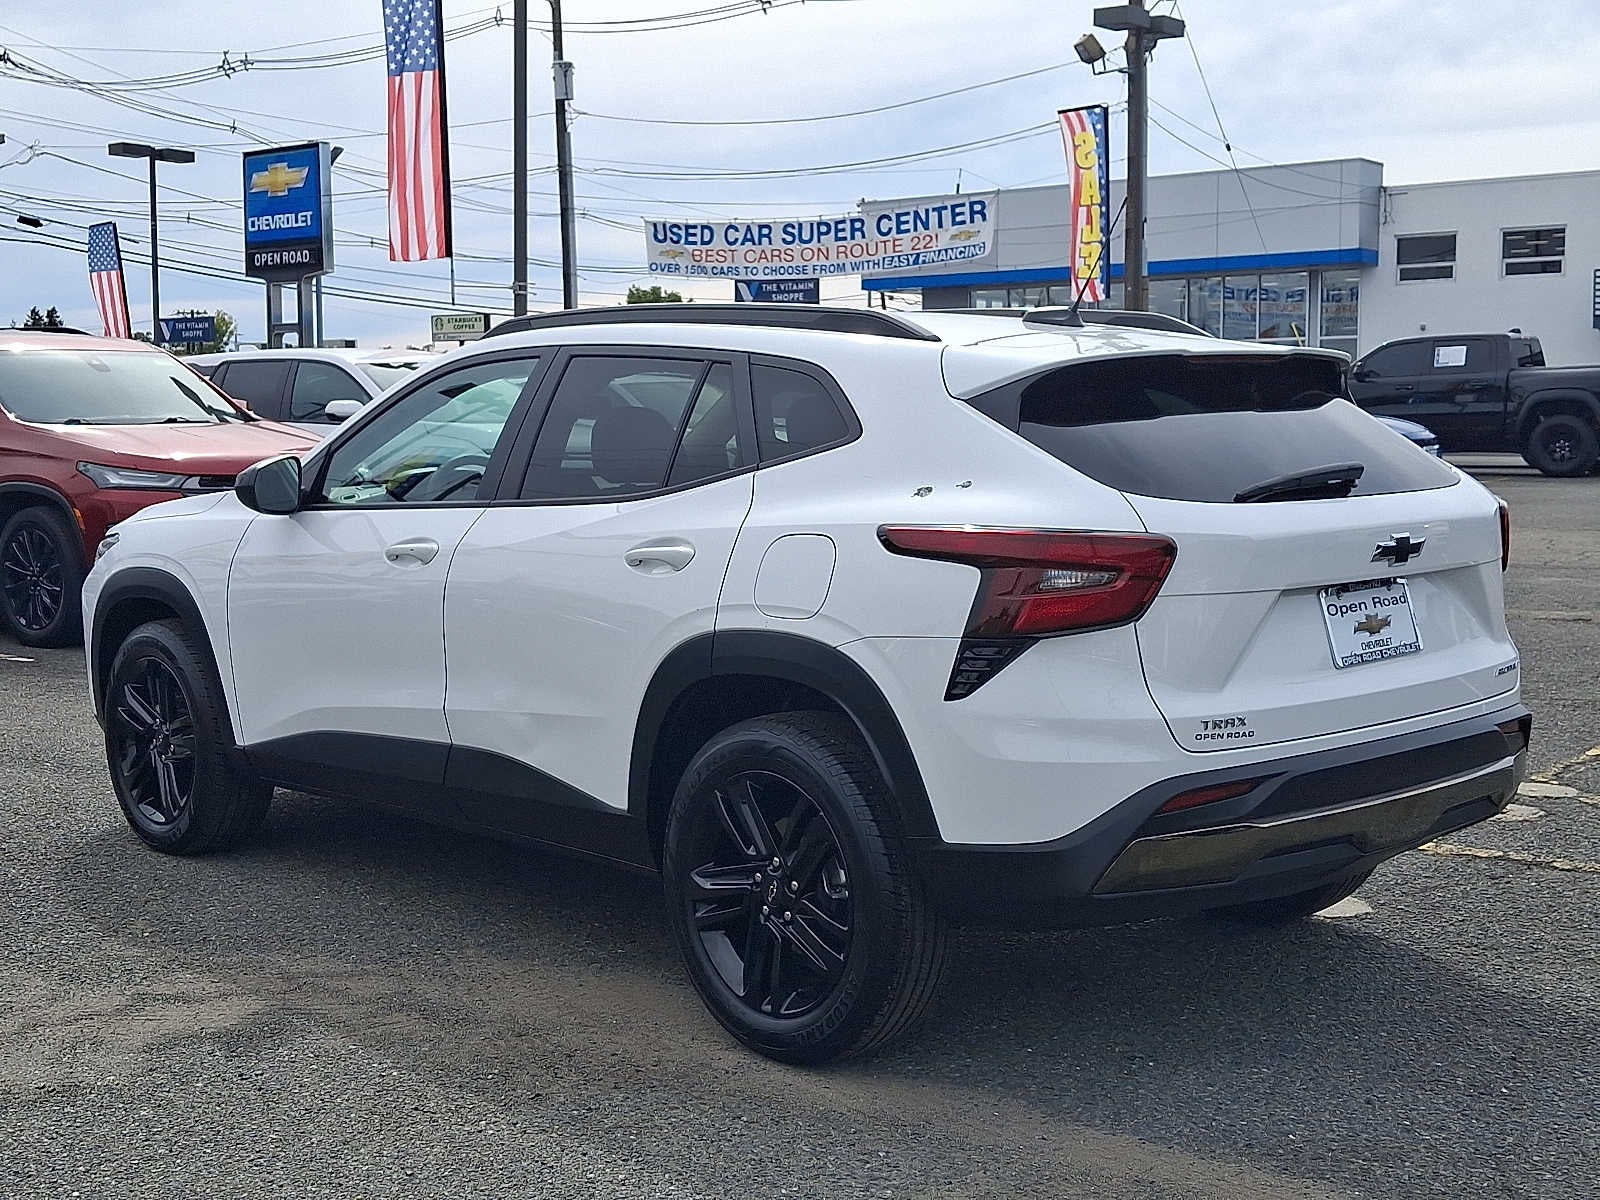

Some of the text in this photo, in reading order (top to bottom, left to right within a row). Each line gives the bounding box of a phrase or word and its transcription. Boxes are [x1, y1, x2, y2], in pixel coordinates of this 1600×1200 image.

[248, 211, 313, 232] CHEVROLET
[652, 200, 988, 246] USED CAR SUPER CENTER
[691, 233, 940, 264] BEST CARS ON ROUTE 22!
[254, 250, 310, 267] OPEN ROAD
[650, 243, 986, 276] OVER 1500 CARS TO CHOOSE FROM WITH EASY FINANCING
[762, 281, 814, 292] THE VITAMIN
[771, 292, 804, 301] SHOPPE
[1326, 592, 1408, 618] Open Road
[1360, 637, 1393, 651] CHEVROLET
[1342, 642, 1420, 667] OPEN ROAD CHEVROLET
[1200, 716, 1247, 731] TRAX
[1194, 730, 1255, 741] OPEN ROAD
